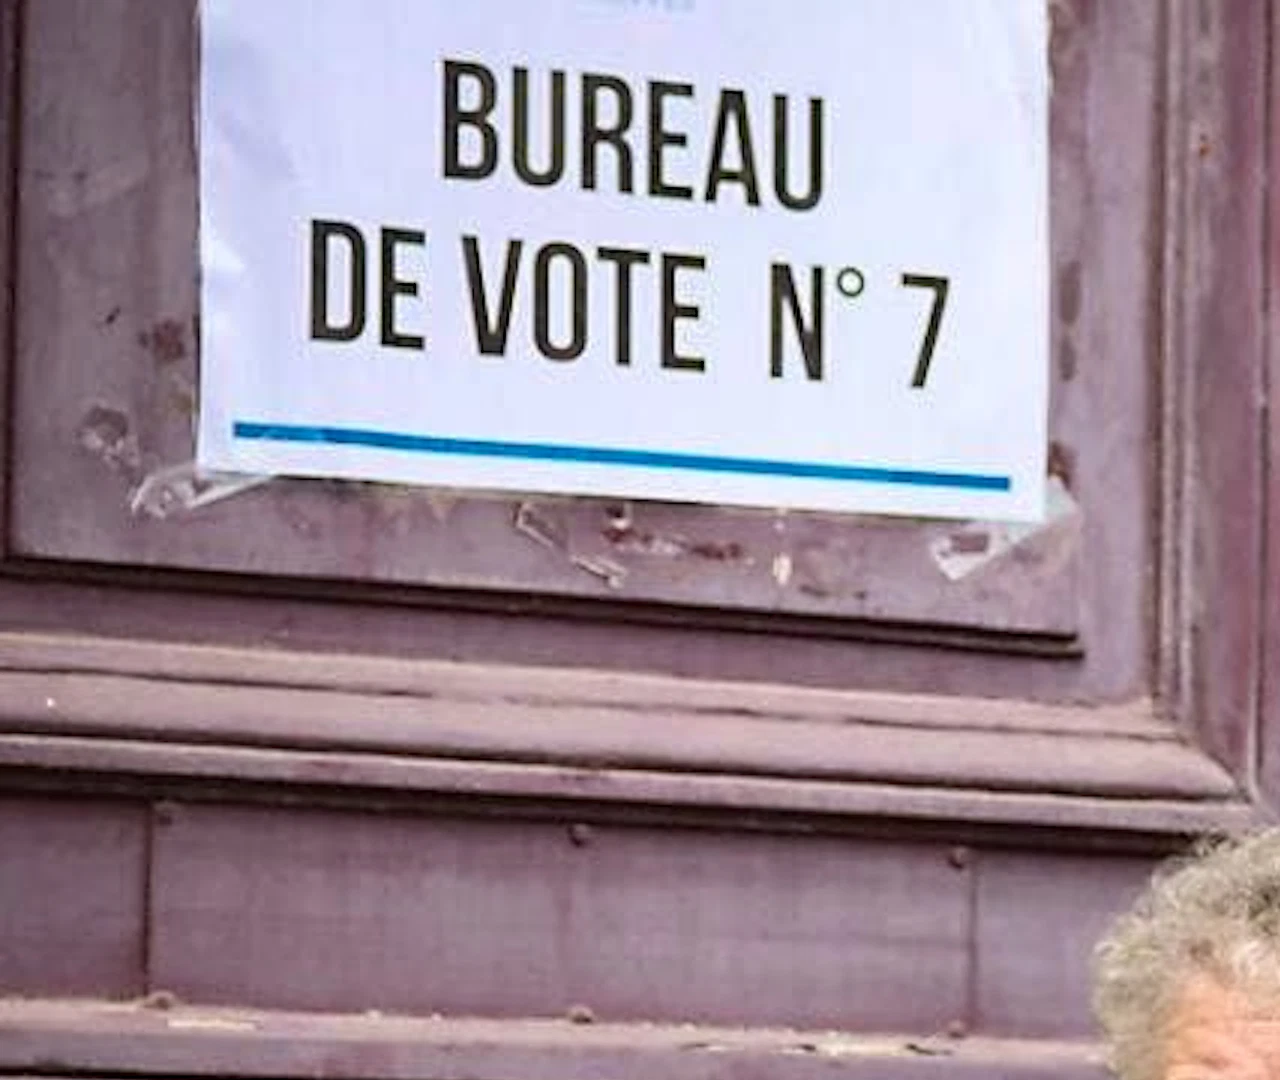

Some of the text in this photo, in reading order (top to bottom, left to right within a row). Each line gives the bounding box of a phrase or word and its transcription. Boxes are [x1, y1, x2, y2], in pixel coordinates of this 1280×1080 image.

[442, 58, 825, 213] BUREAU
[309, 217, 950, 390] DE VOTE N° 7
